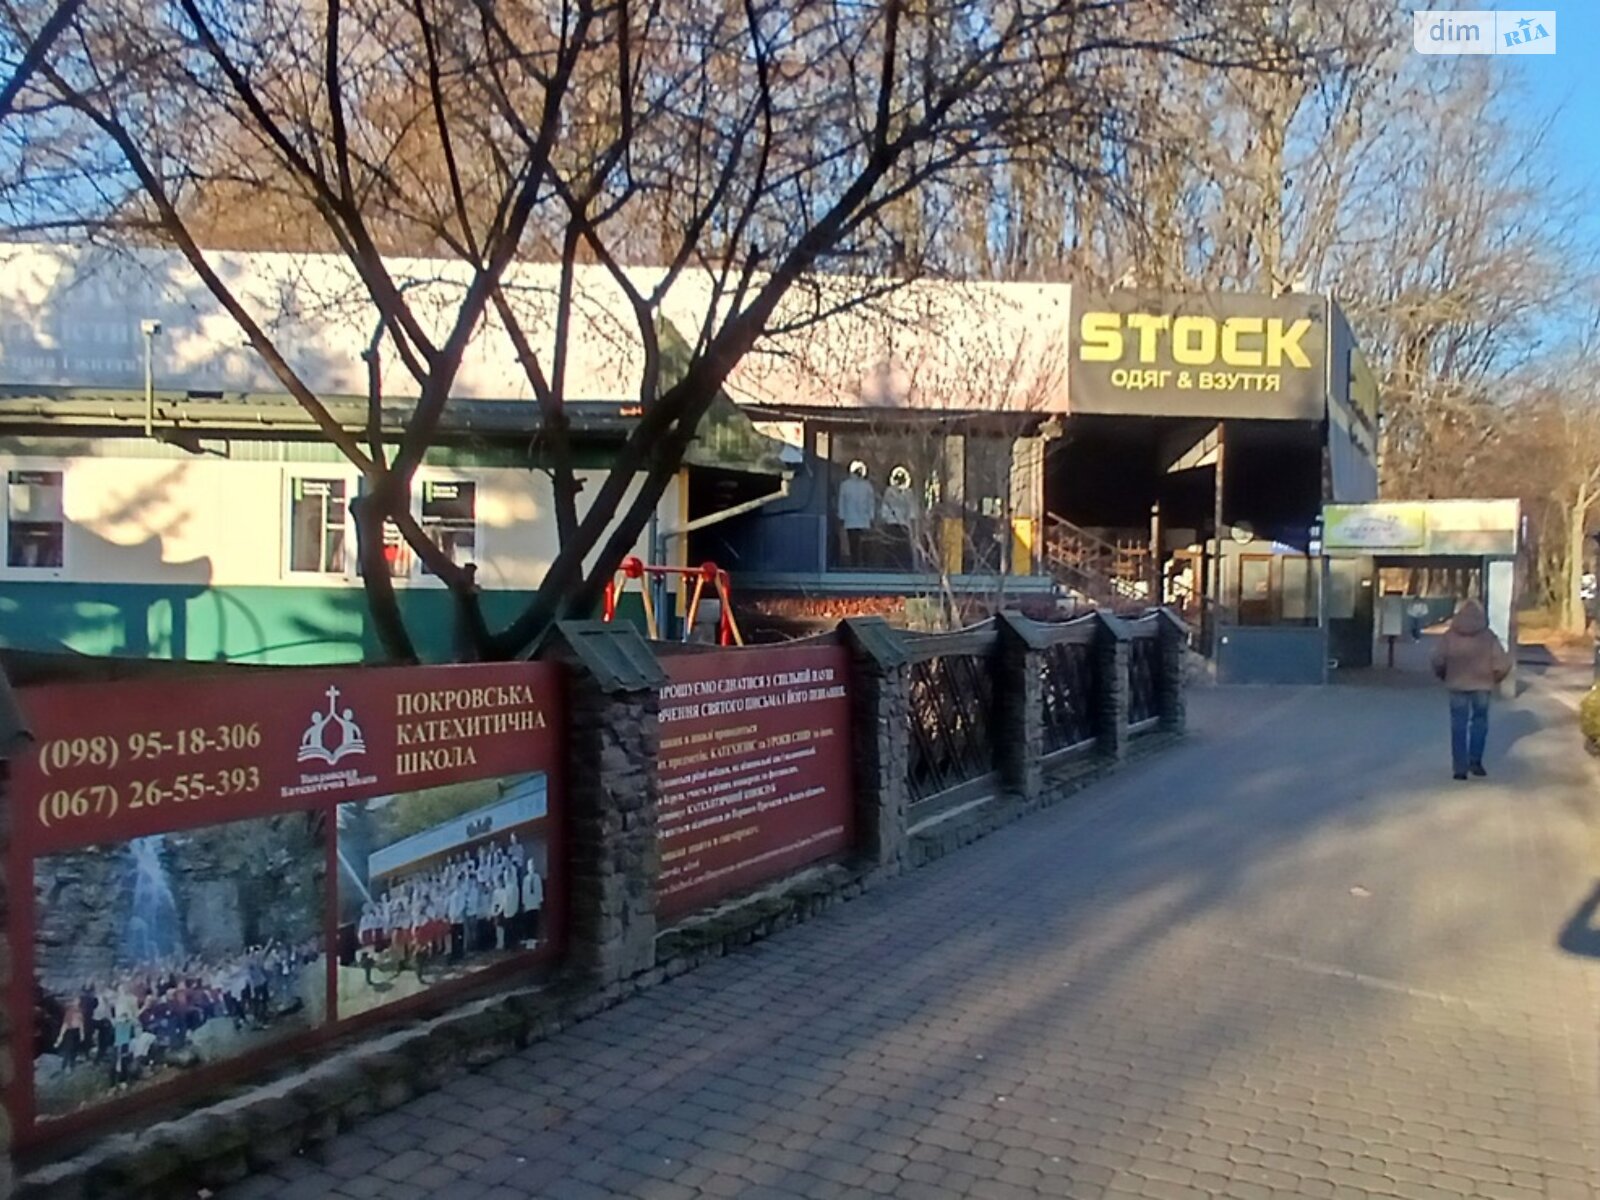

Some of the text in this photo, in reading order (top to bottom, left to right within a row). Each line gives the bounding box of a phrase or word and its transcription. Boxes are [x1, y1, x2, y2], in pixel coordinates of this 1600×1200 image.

[1079, 312, 1312, 369] STOCK
[1111, 369, 1280, 391] ОДЯГ & ВЗУТТЯ
[396, 685, 535, 717] ПОКРОВСЬКА
[396, 710, 548, 746] КАТЕХИТИЧНА
[38, 722, 262, 776] (098) 95-18-306
[396, 746, 478, 776] ШКОЛА
[38, 766, 262, 827] (067) 26-55-393
